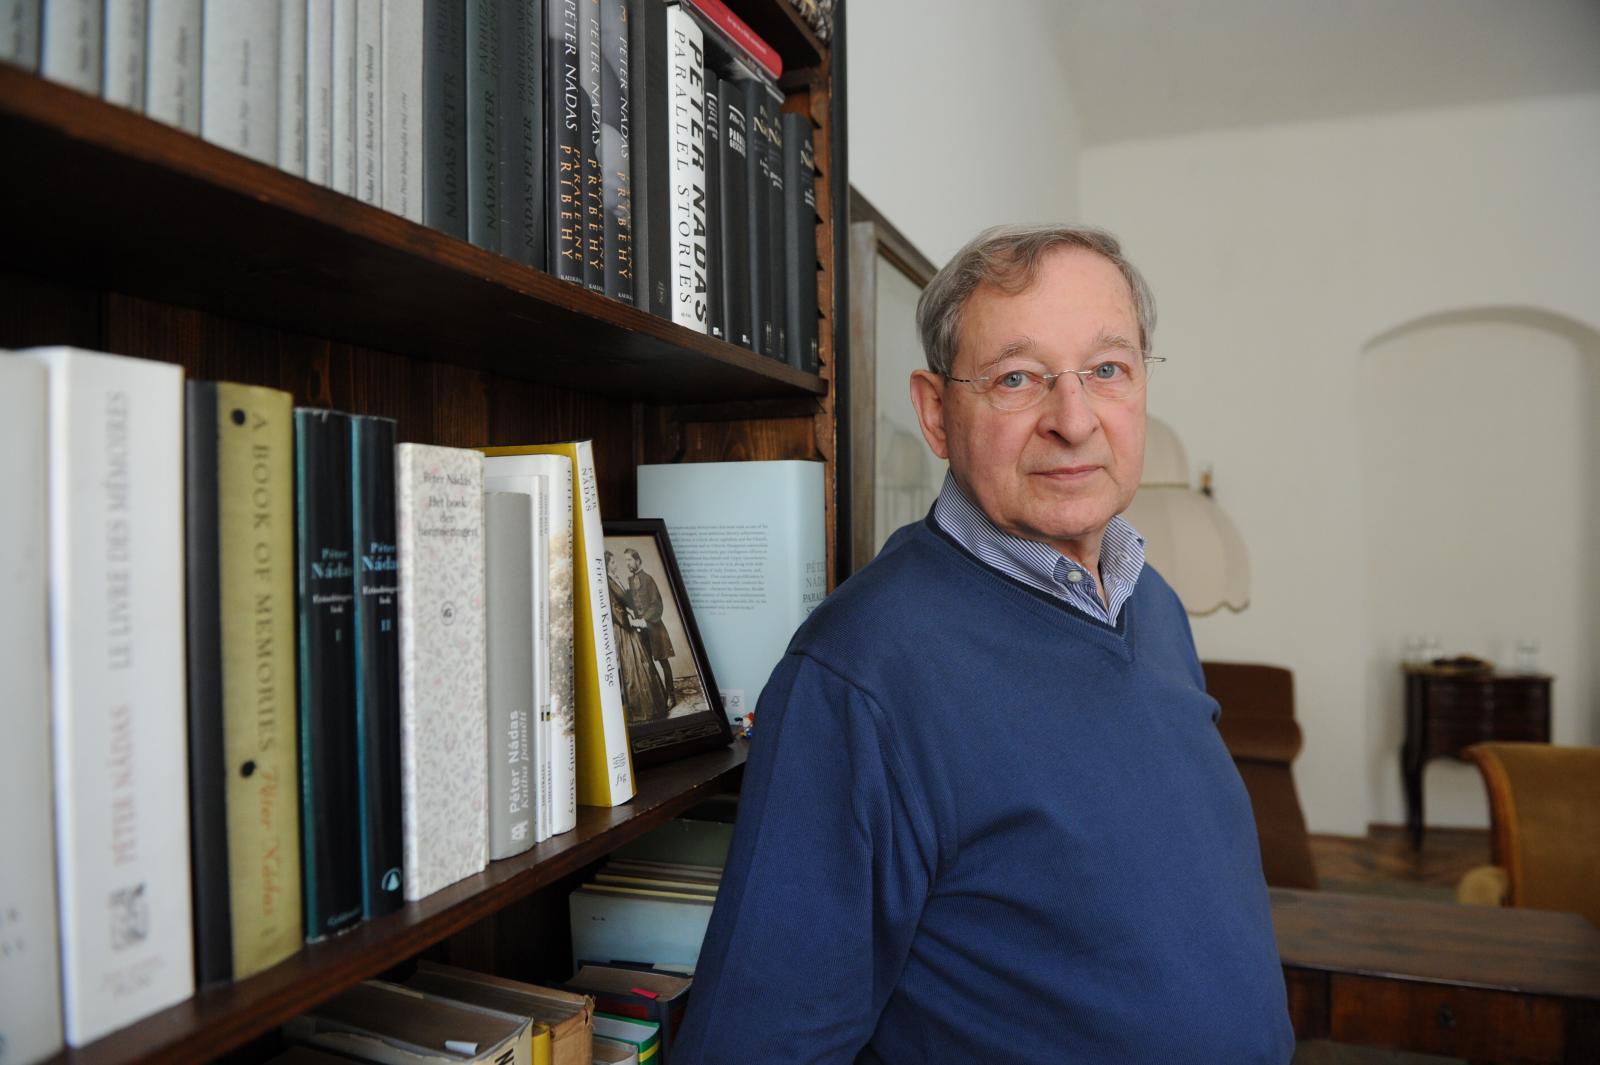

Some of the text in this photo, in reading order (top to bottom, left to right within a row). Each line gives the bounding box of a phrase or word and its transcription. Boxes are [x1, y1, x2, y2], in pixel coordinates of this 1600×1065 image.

[565, 63, 578, 132] NÁDAS
[674, 29, 689, 171] PARALLEL
[484, 160, 496, 231] NÁDAS
[560, 144, 574, 260] PRÍBEHY
[677, 184, 692, 304] STORIES
[428, 495, 467, 508] Het boek
[252, 411, 276, 752] A BOOK OF MEMORIES
[805, 560, 826, 574] PÉTE
[595, 557, 616, 688] Fire and Knowledge
[508, 710, 520, 814] Péter Nádas
